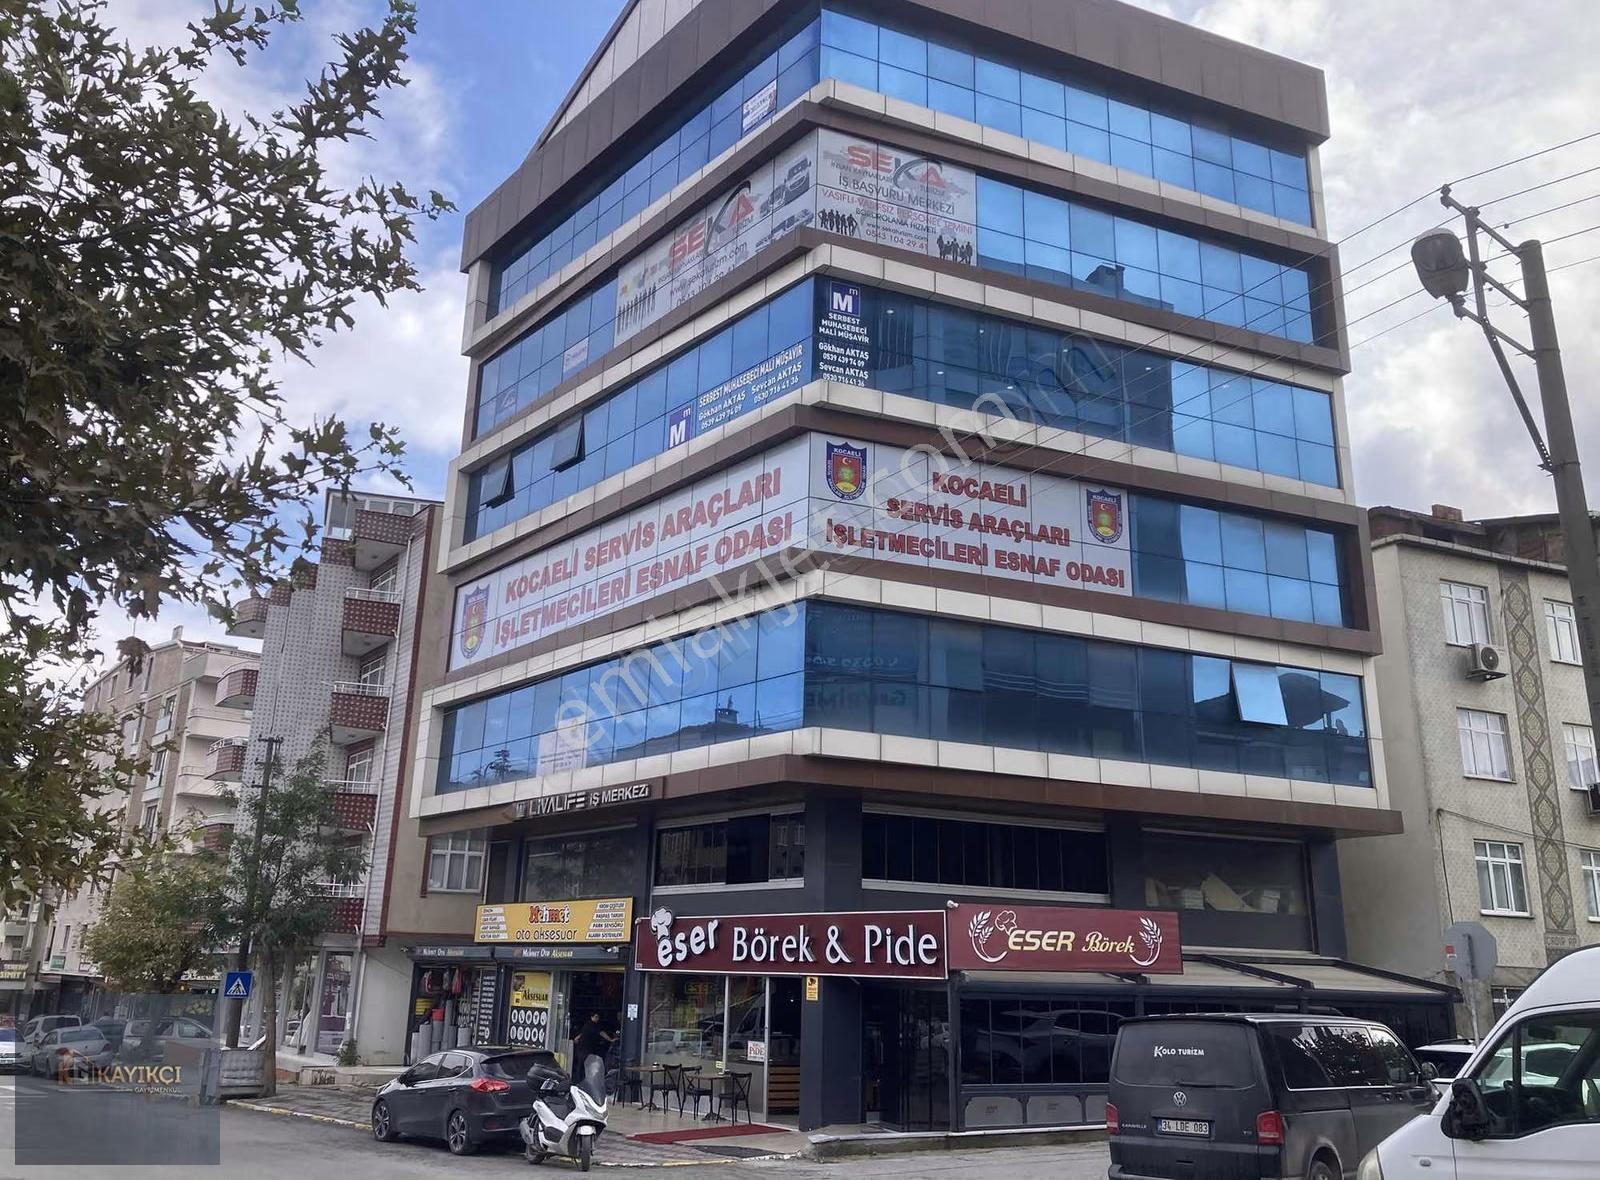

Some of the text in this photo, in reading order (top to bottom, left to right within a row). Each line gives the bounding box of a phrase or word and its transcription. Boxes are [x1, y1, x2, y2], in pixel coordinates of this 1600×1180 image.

[908, 193, 955, 216] MERKEZİ
[832, 292, 853, 313] M
[821, 318, 867, 335] MUHASEBECİ
[828, 312, 860, 325] SERBEST
[818, 326, 837, 336] MALİ
[818, 342, 844, 355] Gökhan
[819, 361, 844, 374] Sevcan
[751, 376, 776, 394] Sevcan
[699, 387, 723, 408] SERBEST
[669, 419, 686, 448] M
[932, 471, 1027, 509] KOCAELİ
[886, 497, 963, 529] SERVİS
[968, 512, 1071, 547] ARAÇLARI
[505, 548, 579, 604] KOCAELİ
[584, 520, 656, 572] SERVİS
[660, 467, 782, 542] ARAÇLARI
[826, 518, 1125, 589] İŞLETMECİLERİ ESNAF ODASI
[494, 511, 794, 649] İŞLETMECİLERİ ESNAF ODASI
[528, 904, 571, 924] Mehmet
[515, 927, 578, 941] oto aksesuar
[1007, 929, 1136, 954] ESER Börek
[732, 924, 939, 966] Börek & Pide
[1162, 1121, 1172, 1130] 34
[1193, 1122, 1209, 1133] 083
